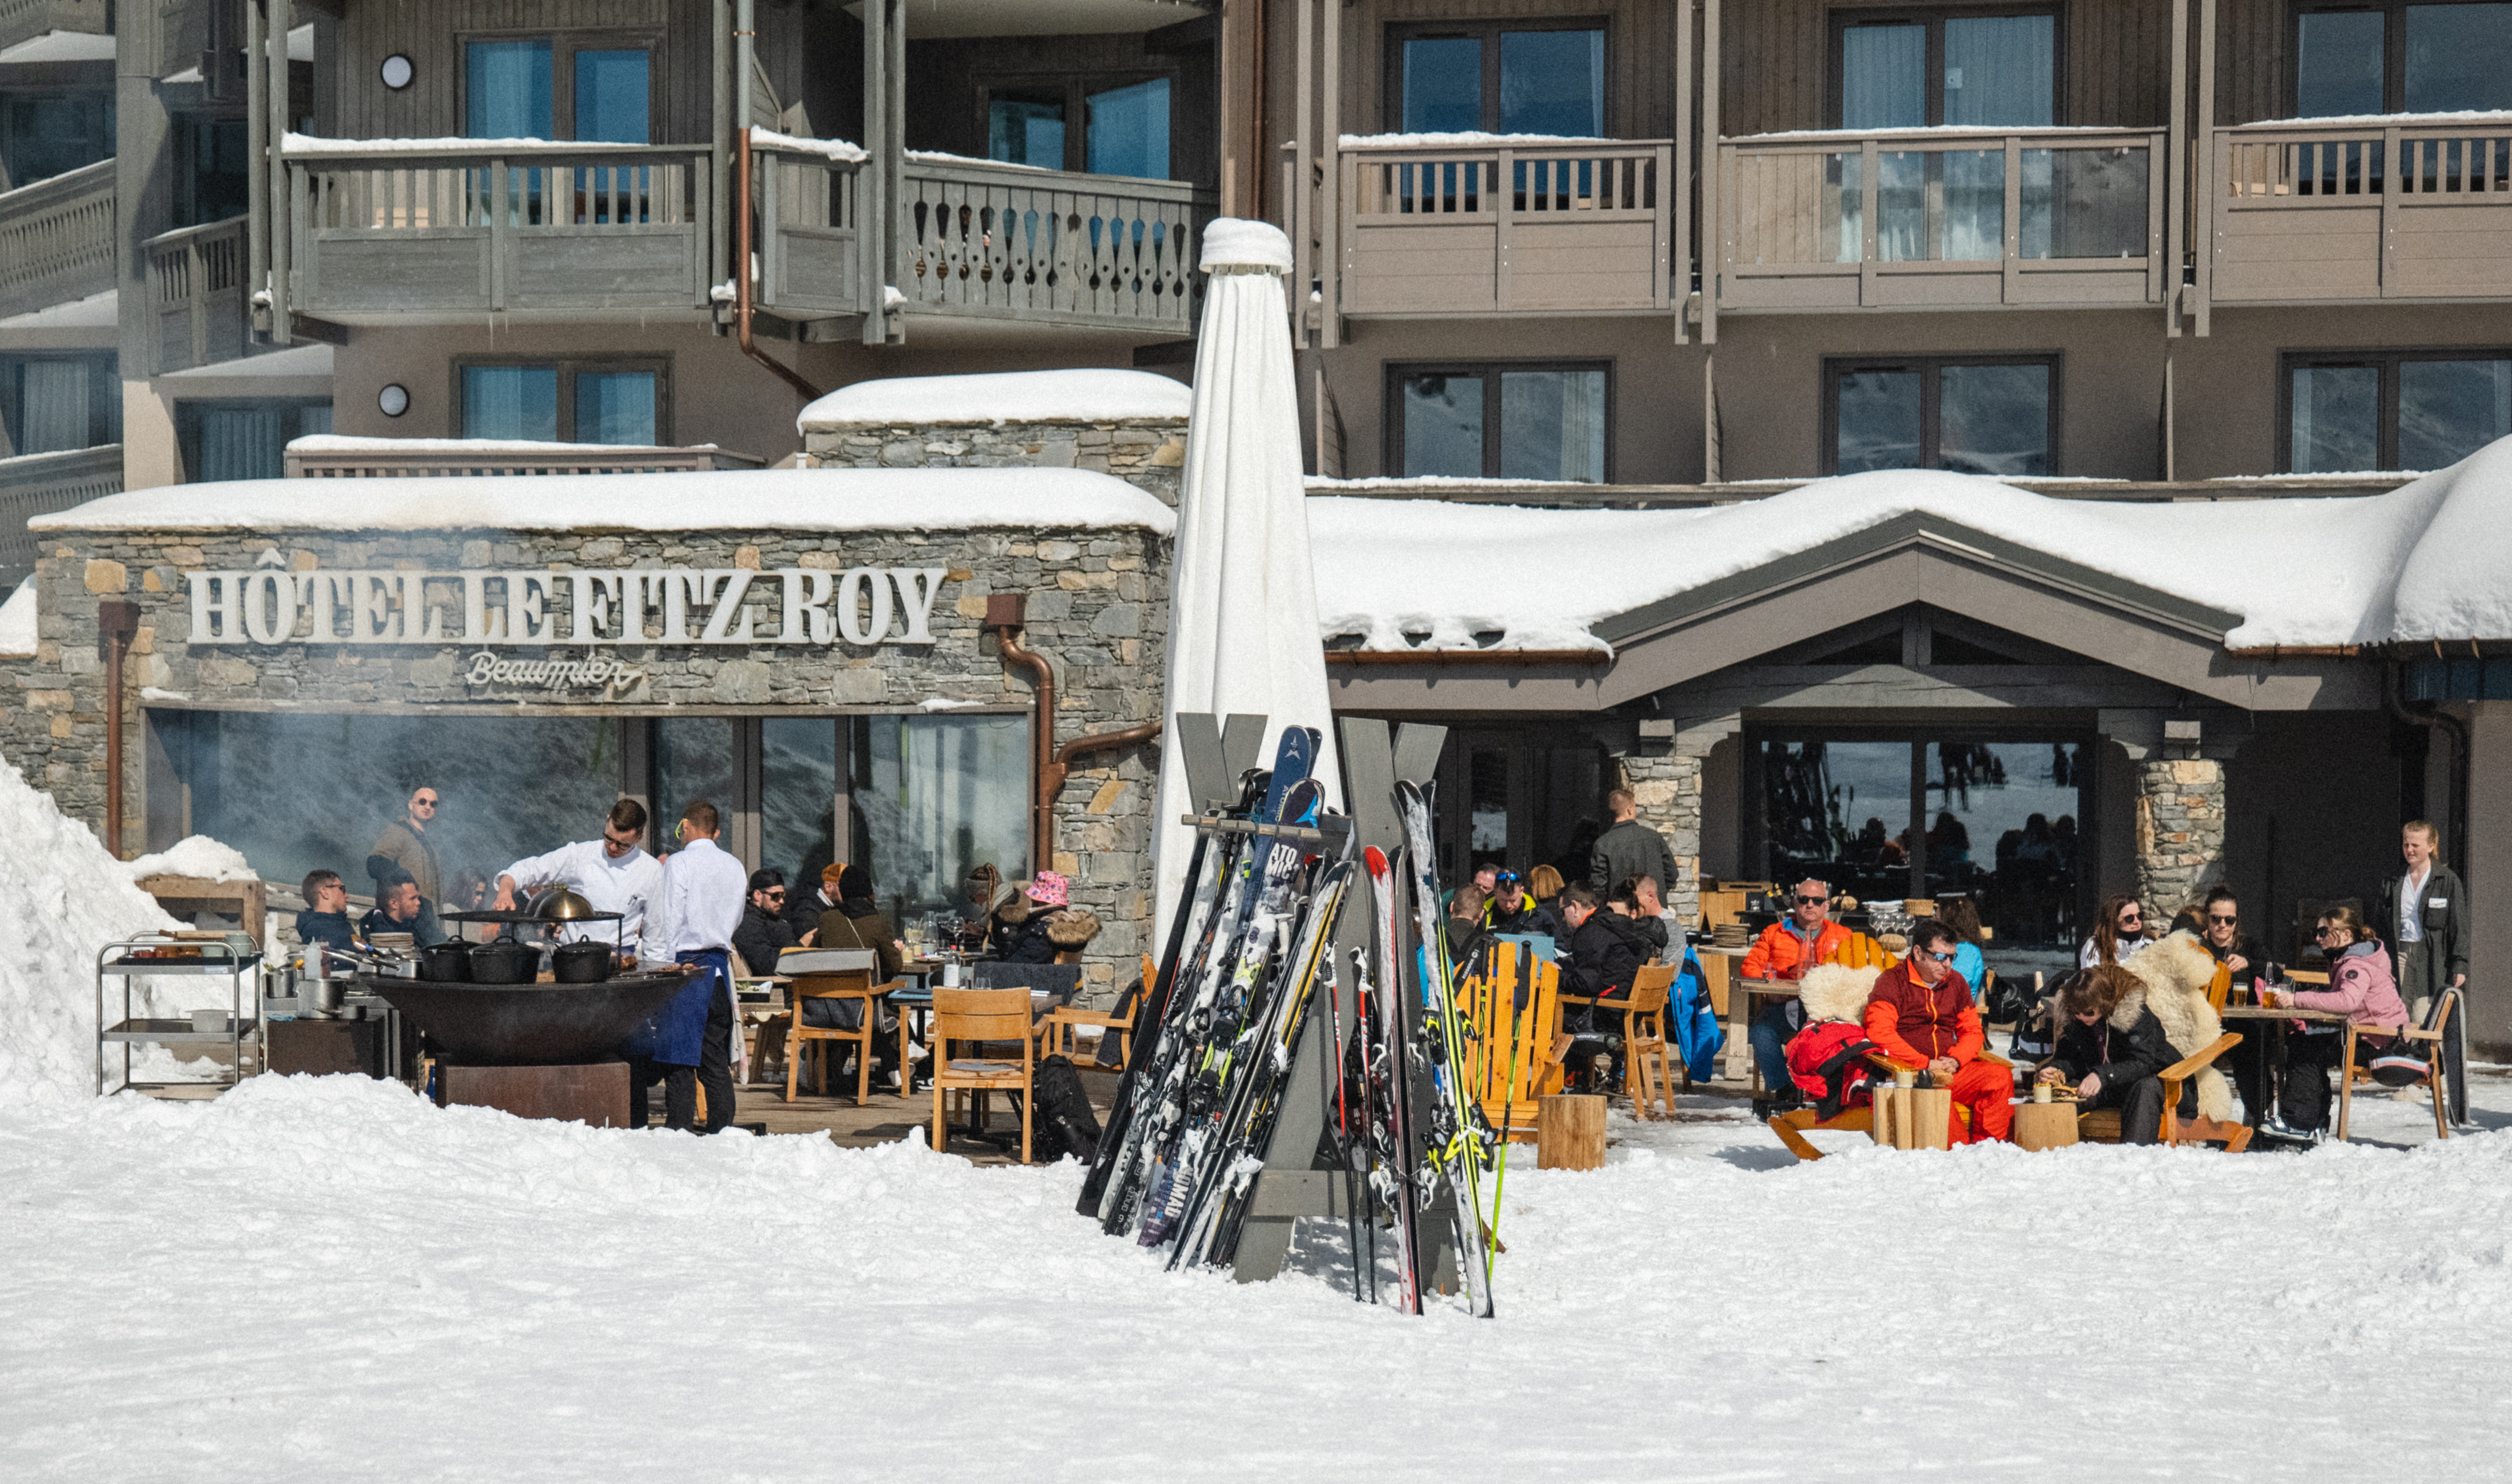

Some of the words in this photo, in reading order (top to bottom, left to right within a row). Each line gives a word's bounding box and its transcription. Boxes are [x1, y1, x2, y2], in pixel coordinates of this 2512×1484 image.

[185, 547, 442, 644] HÔTEL
[461, 569, 553, 644] LE
[569, 568, 754, 644] FITZ
[777, 567, 948, 645] ROY
[465, 651, 643, 688] Beaumier
[1164, 1164, 1194, 1219] NOMAD
